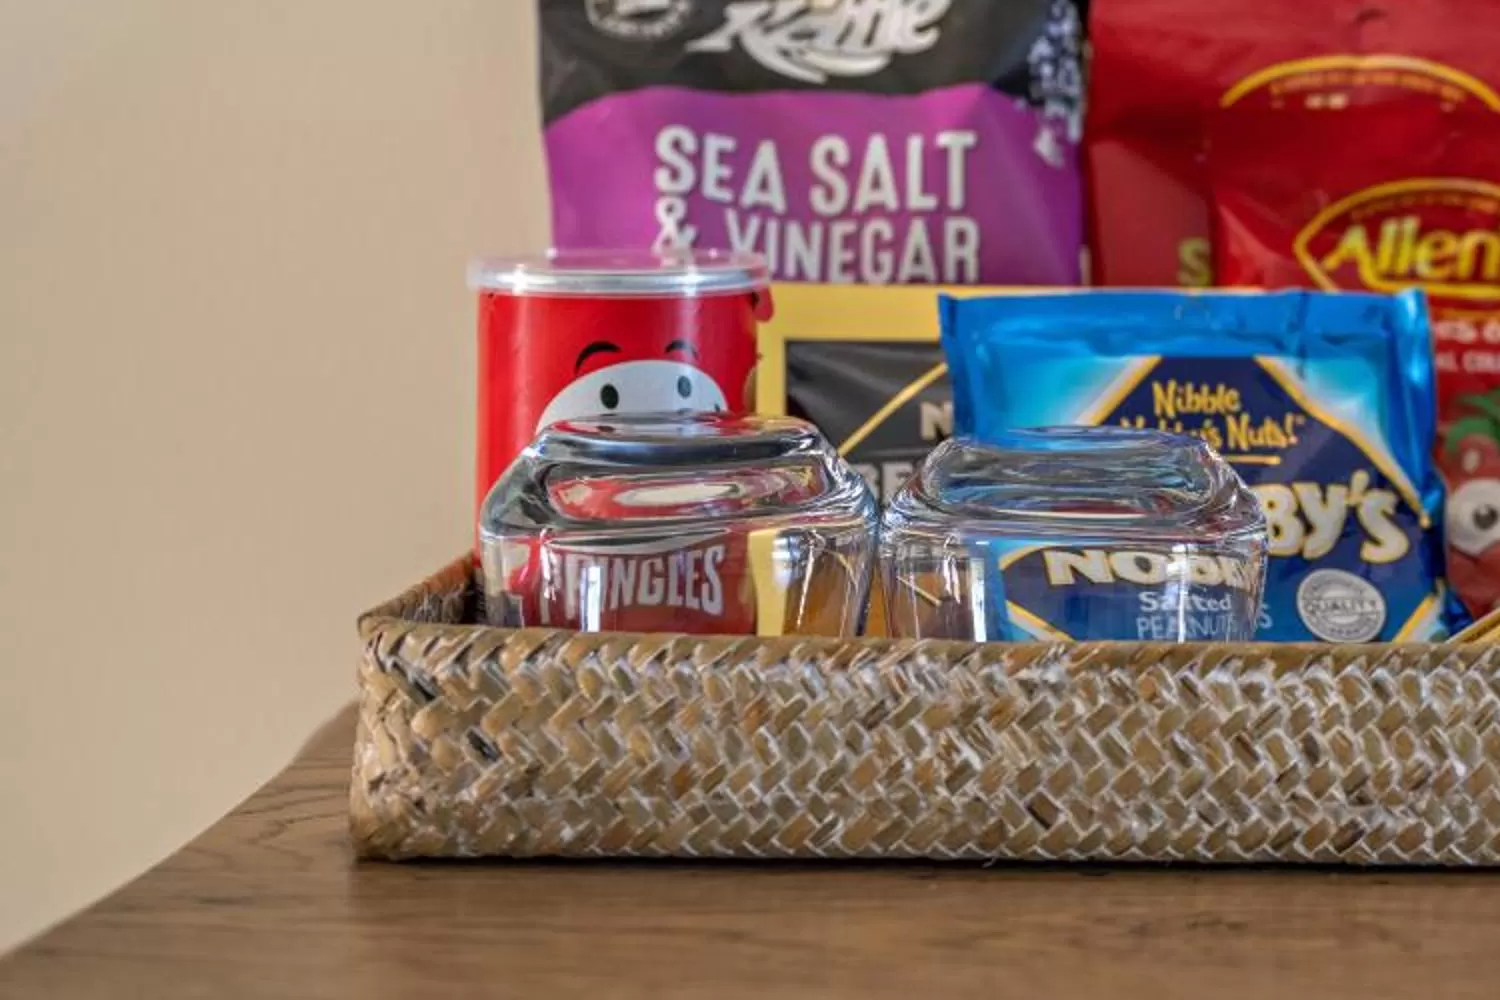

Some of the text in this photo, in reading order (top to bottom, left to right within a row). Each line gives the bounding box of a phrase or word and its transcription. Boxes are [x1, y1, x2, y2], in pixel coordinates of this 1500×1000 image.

[653, 124, 977, 216] SEA SALT
[653, 195, 979, 284] & VINEGAR
[1151, 378, 1241, 418] Nibble
[1225, 411, 1299, 451] Nuts!
